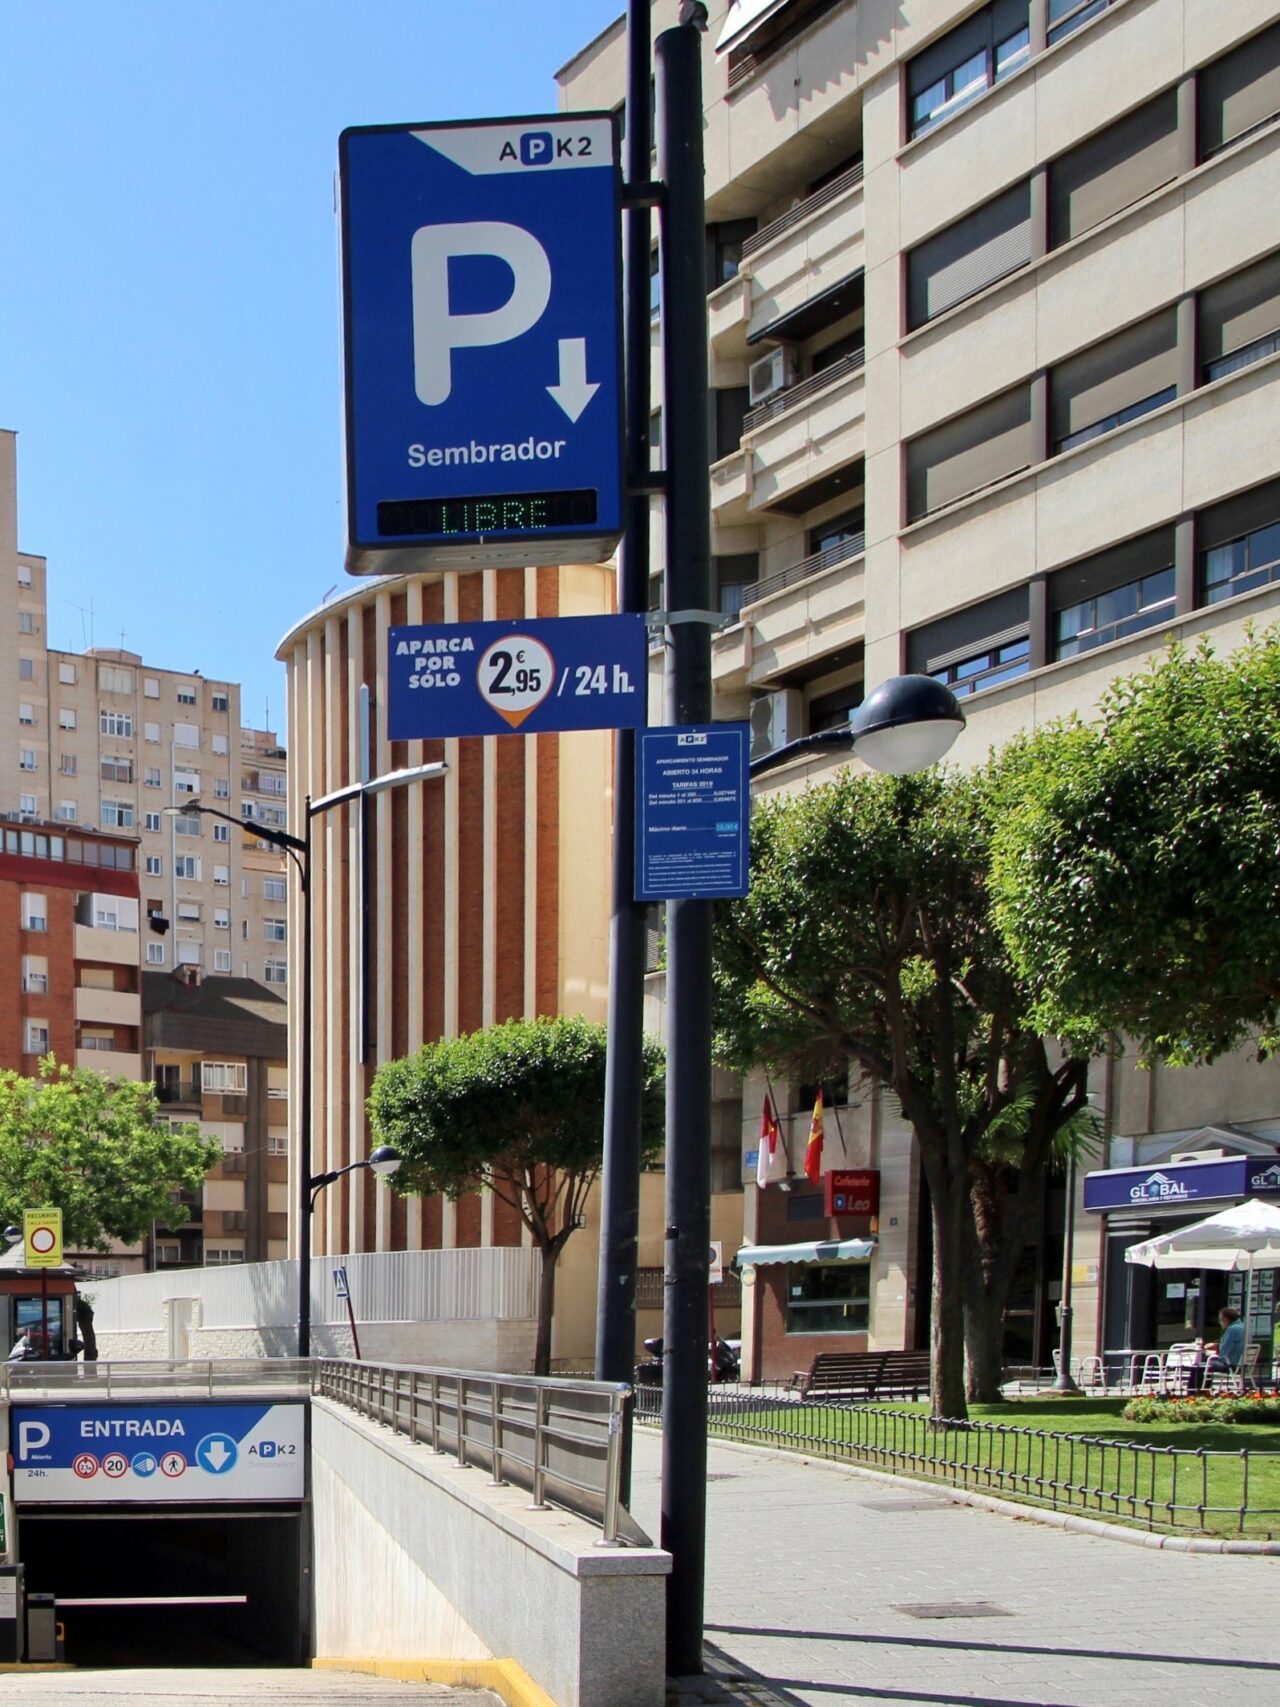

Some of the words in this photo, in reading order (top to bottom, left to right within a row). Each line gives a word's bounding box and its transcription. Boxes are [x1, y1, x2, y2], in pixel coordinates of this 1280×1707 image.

[498, 134, 593, 165] APK2
[411, 221, 552, 406] P
[407, 437, 566, 468] Sembrador
[440, 499, 547, 534] LIBRE
[396, 636, 474, 656] APARCA
[414, 655, 455, 672] POR
[408, 669, 461, 690] SÓLO
[574, 666, 608, 696] 24
[612, 664, 635, 694] h.
[848, 1195, 870, 1210] Leo
[19, 1421, 50, 1461] P
[80, 1419, 185, 1438] ENTRADA
[107, 1460, 123, 1472] 20
